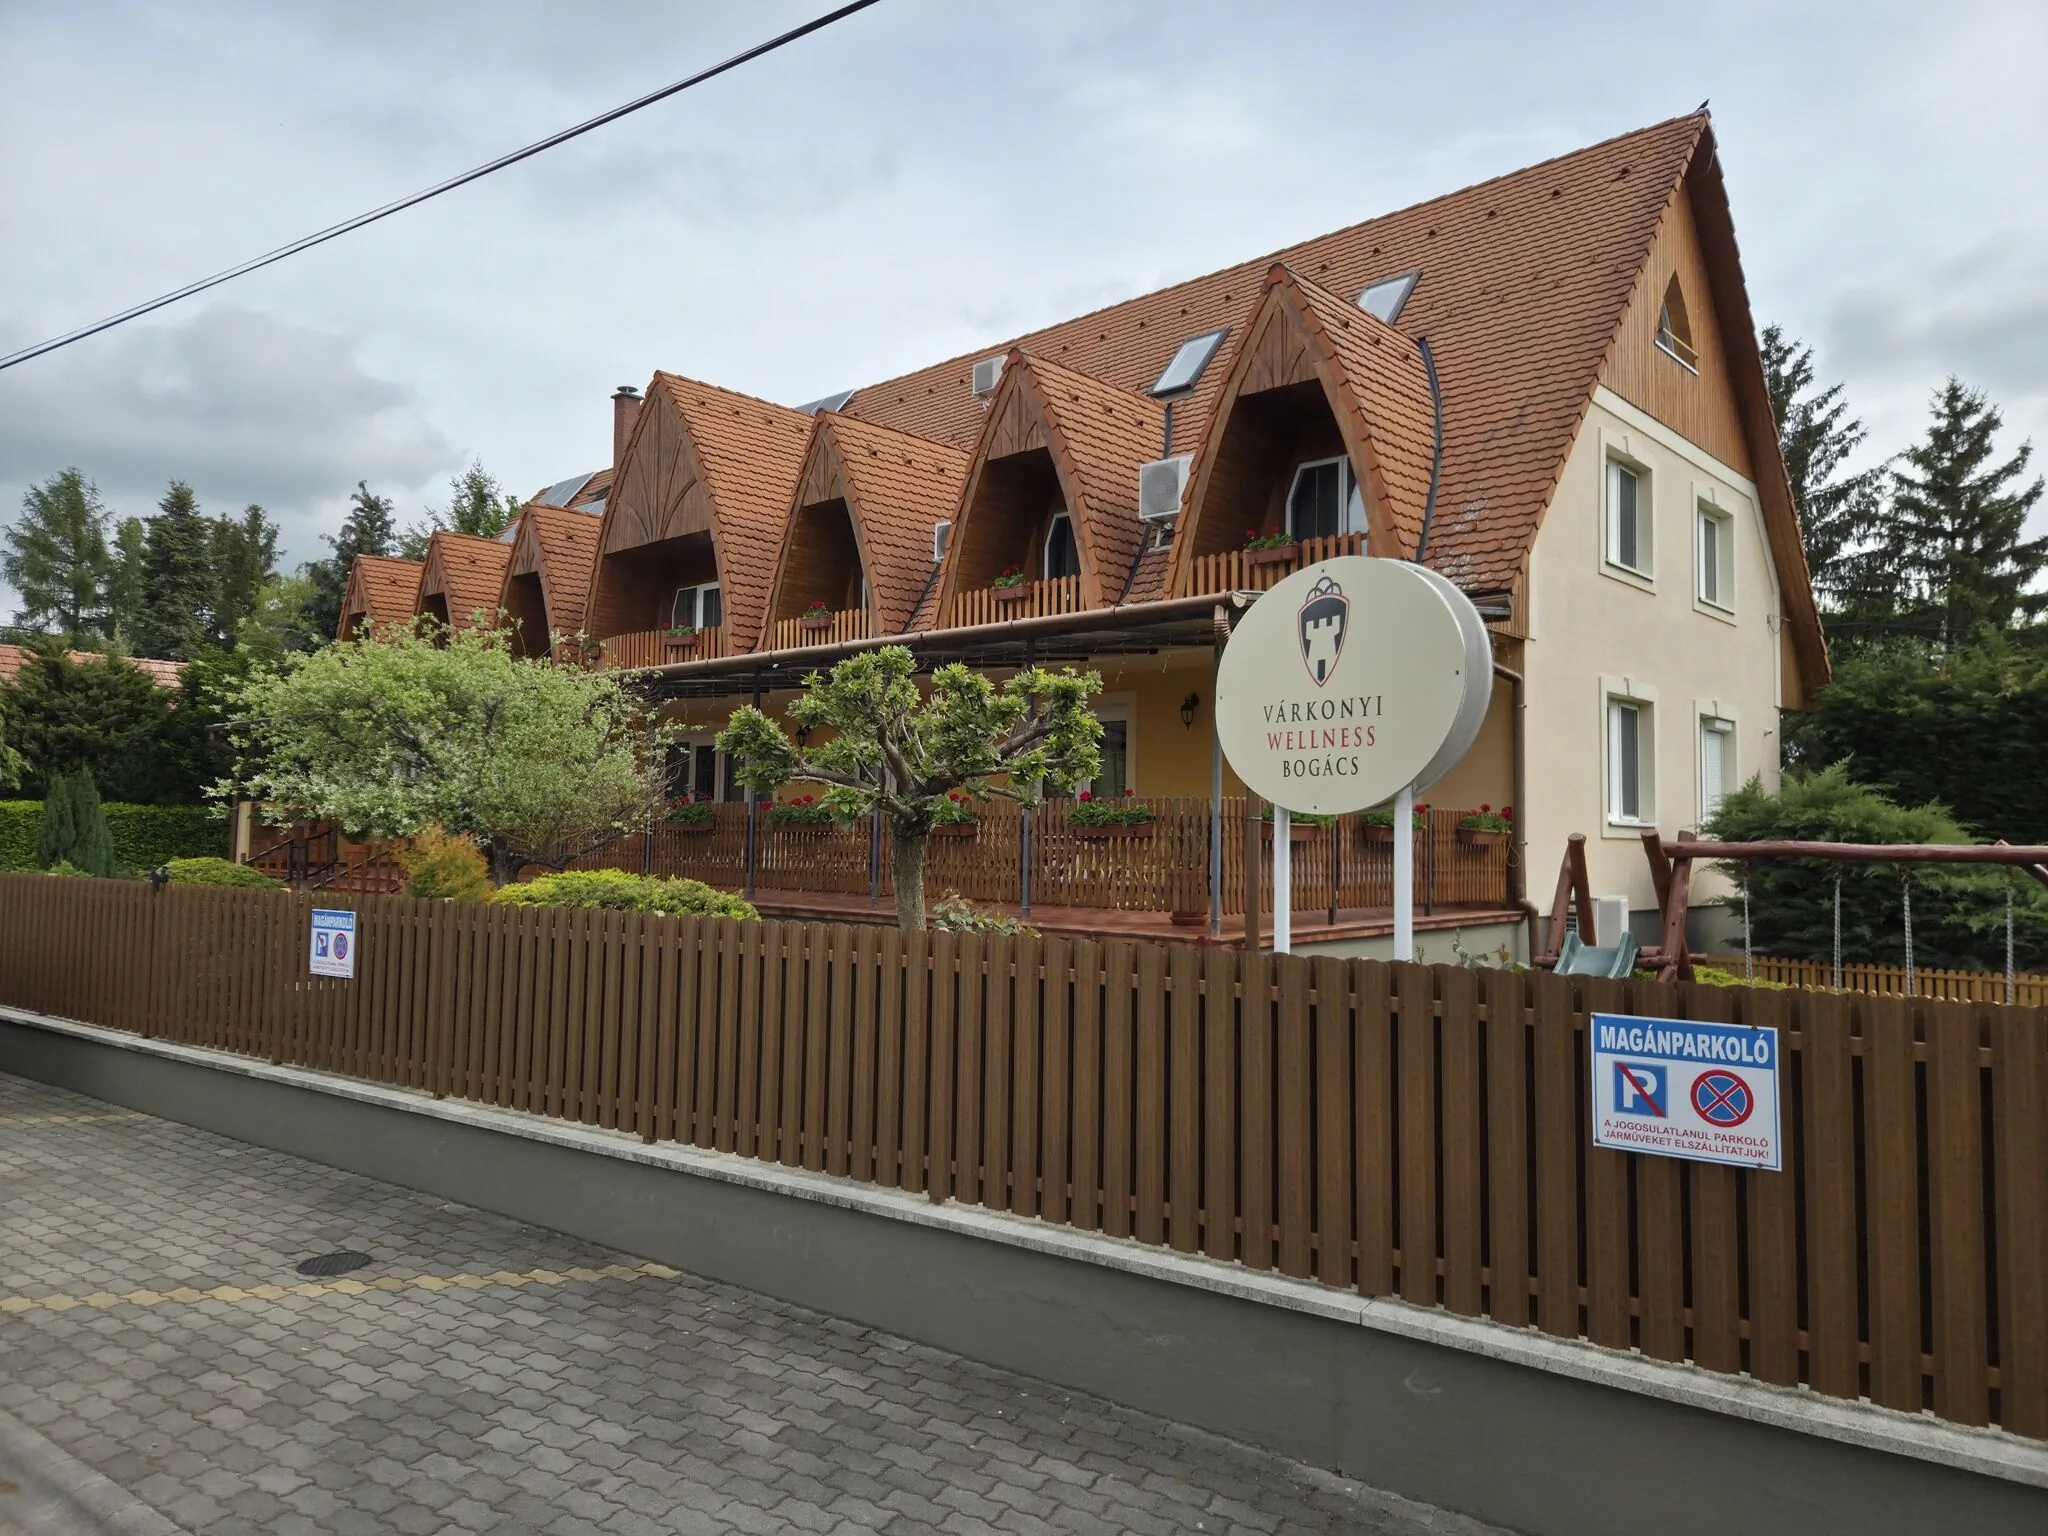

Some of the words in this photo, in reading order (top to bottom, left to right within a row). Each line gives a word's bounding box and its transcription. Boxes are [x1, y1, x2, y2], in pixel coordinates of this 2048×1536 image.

[1263, 695, 1383, 724] VÁRKONYI
[1267, 725, 1376, 751] WELLNESS
[1282, 753, 1359, 778] BOGÁCS
[1600, 1024, 1769, 1064] MAGÁNPARKOLÓ
[1604, 1119, 1611, 1127] A
[1613, 1121, 1711, 1140] JOGOSULATLANUL
[1714, 1132, 1768, 1148] PARKOLÓ
[1604, 1129, 1672, 1146] JÁRMŰVEKET
